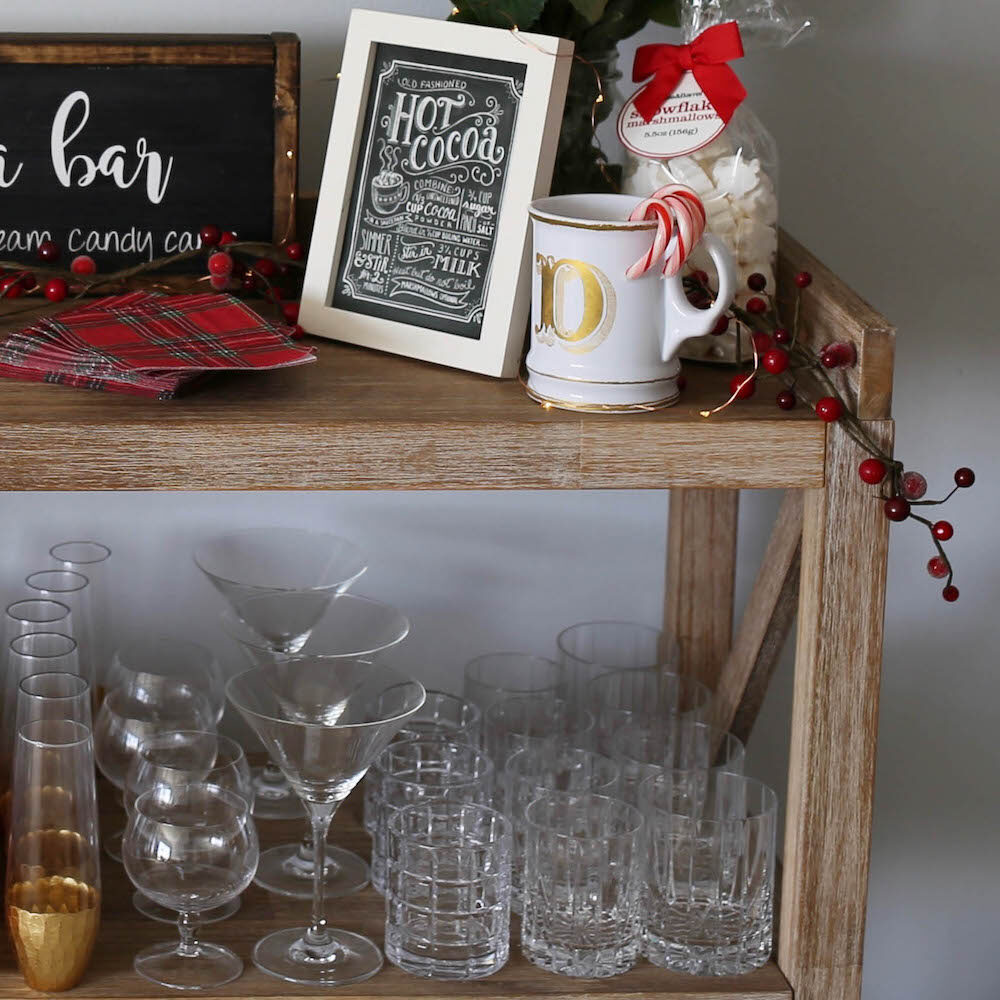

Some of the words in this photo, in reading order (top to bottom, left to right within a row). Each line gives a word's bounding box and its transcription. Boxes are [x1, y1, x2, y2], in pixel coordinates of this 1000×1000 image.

[402, 78, 418, 89] OLD
[420, 79, 468, 89] FASHIONED
[386, 91, 466, 146] HOT
[50, 90, 174, 204] bar
[406, 201, 424, 214] CUP
[476, 223, 495, 236] SALT
[453, 247, 480, 260] CUPS
[432, 254, 481, 278] MILK
